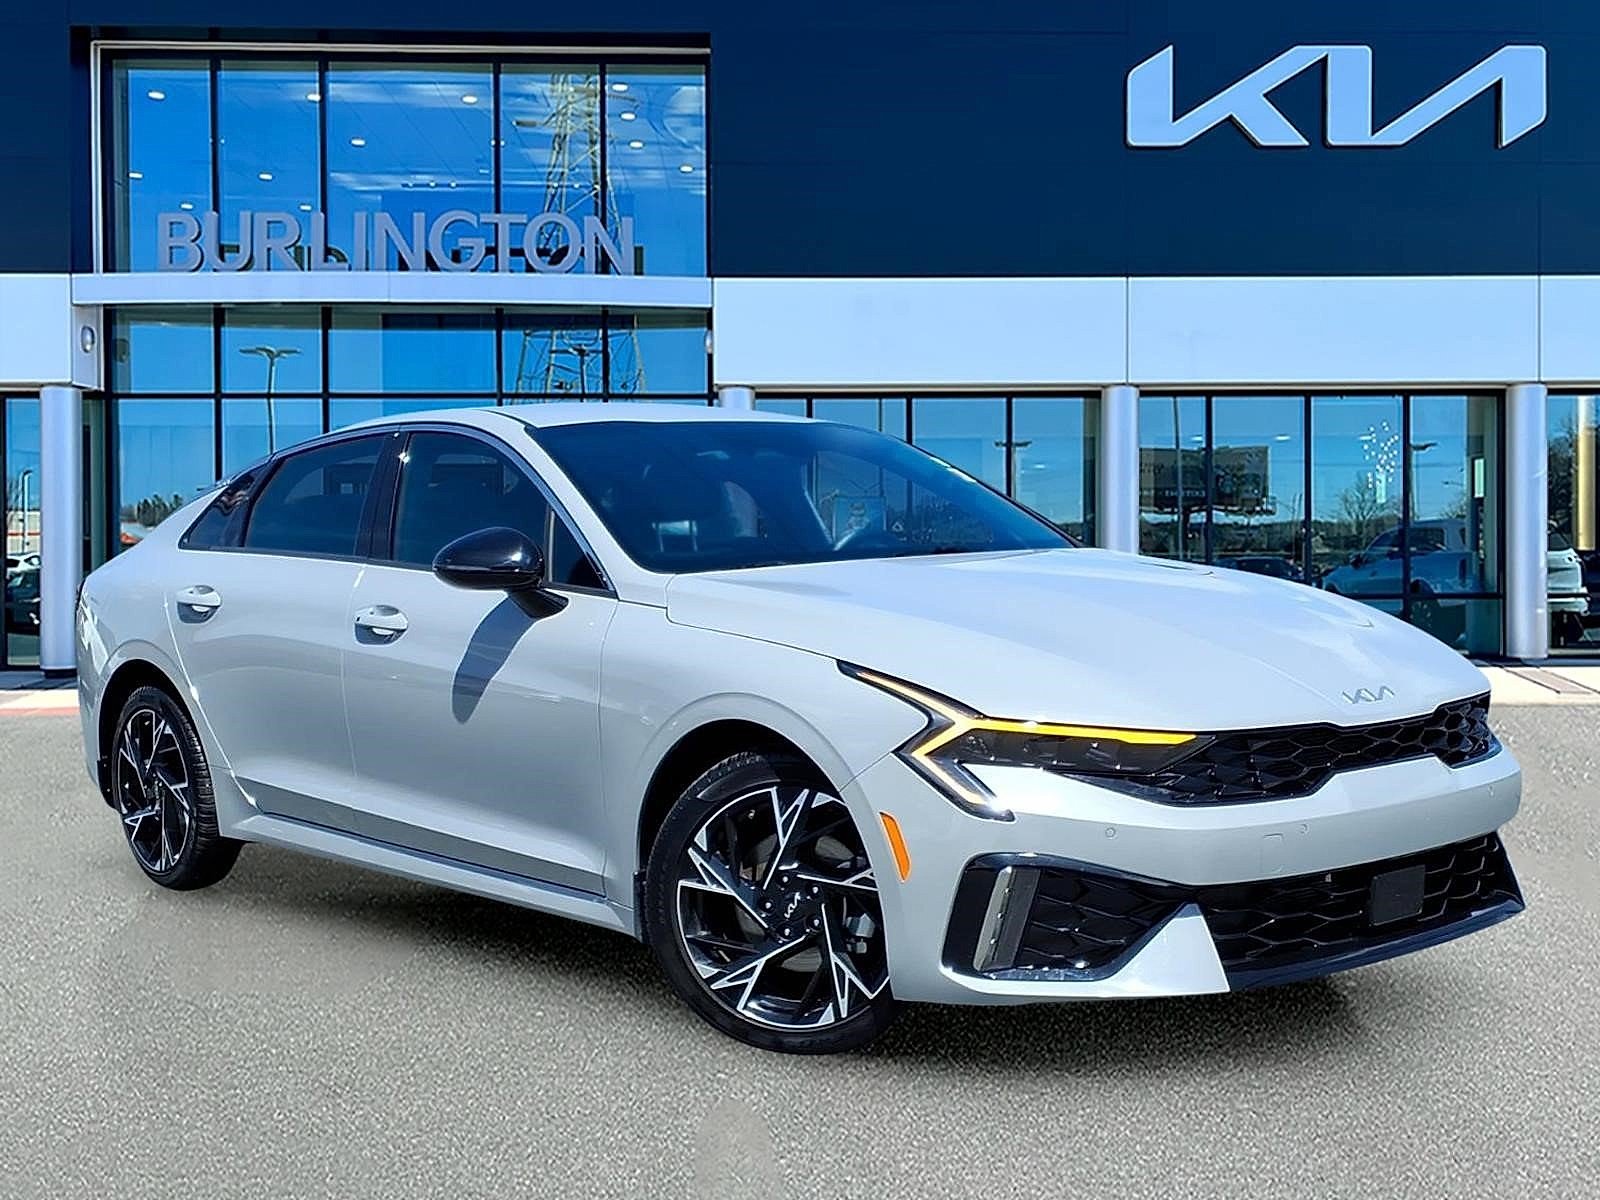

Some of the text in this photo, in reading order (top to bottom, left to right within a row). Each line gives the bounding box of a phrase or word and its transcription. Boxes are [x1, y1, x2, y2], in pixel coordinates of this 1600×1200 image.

[1127, 44, 1547, 148] KIA
[156, 210, 634, 275] BURLINGTON
[1342, 685, 1395, 704] KIA
